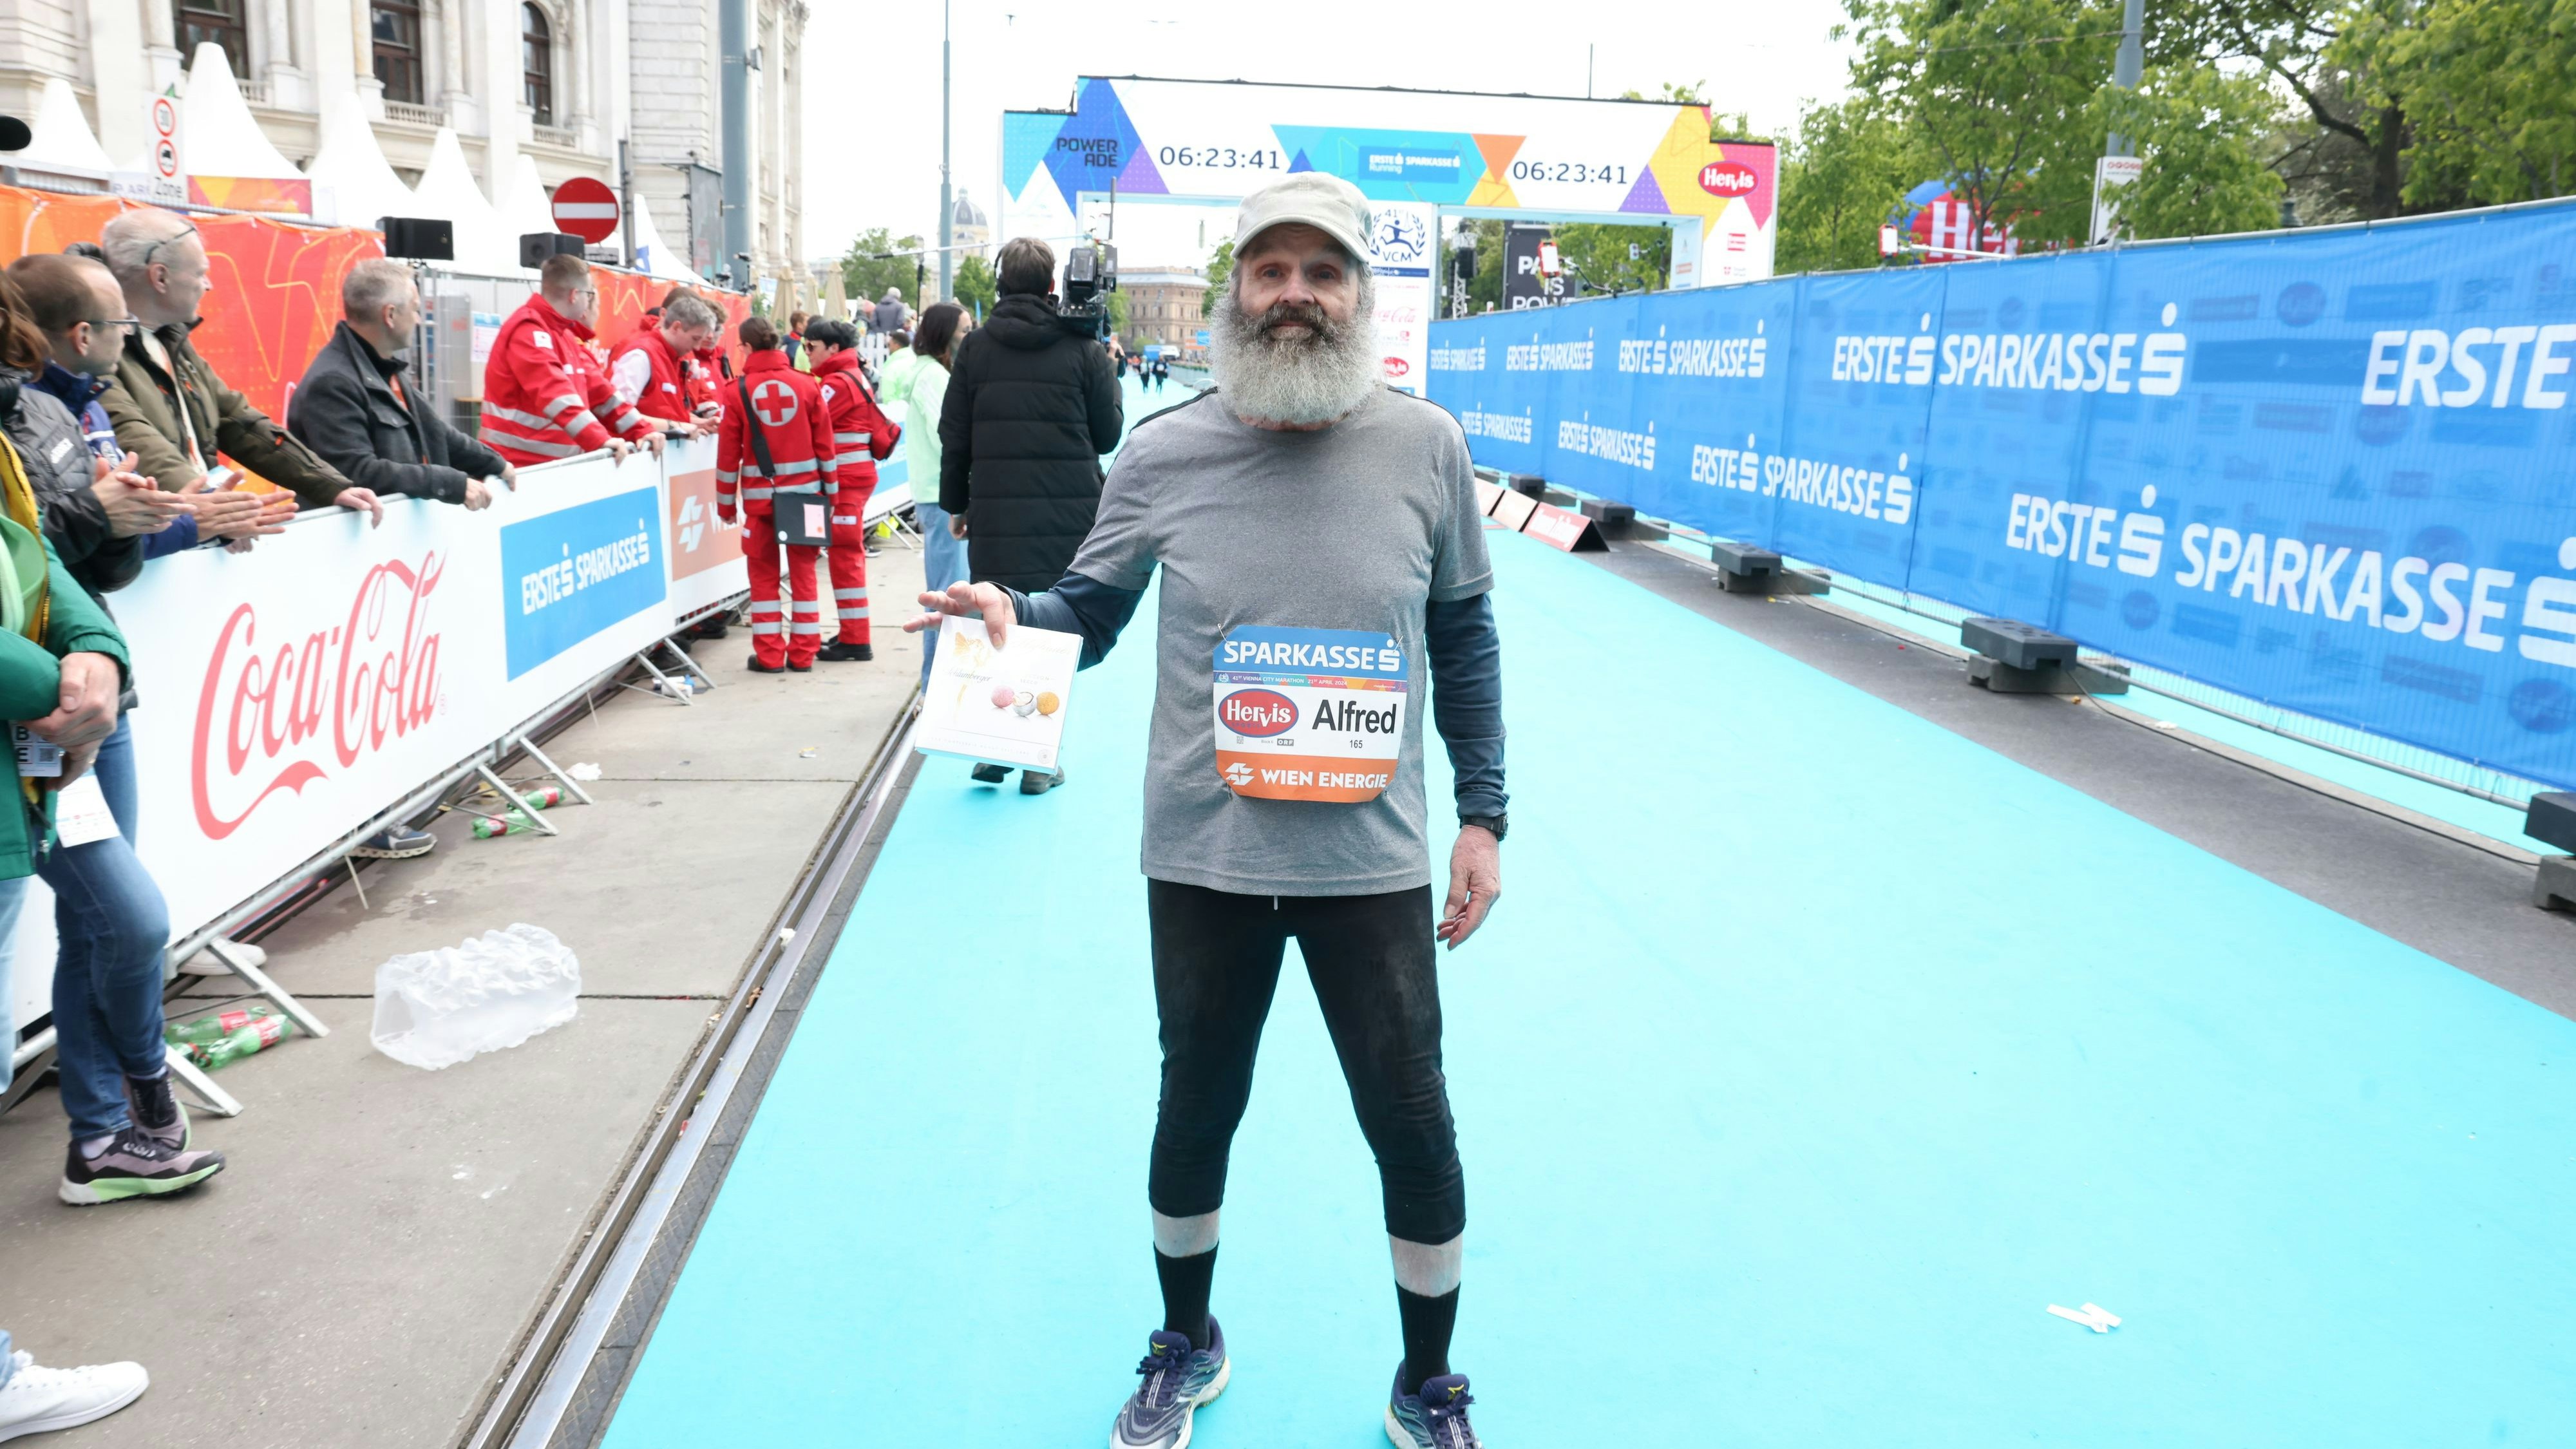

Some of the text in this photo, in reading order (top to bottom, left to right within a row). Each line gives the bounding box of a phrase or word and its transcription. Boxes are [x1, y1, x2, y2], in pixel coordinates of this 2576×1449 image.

[1056, 138, 1118, 153] POWER
[1159, 146, 1280, 169] 06:23:41
[1084, 153, 1118, 167] ADE
[1368, 163, 1403, 175] Running
[1369, 155, 1452, 167] ERSTE SPARKASSE
[1513, 161, 1628, 185] 06:23:41
[1704, 167, 1754, 191] Hervis
[155, 176, 183, 198] Zone
[1383, 251, 1412, 263] VCM
[1544, 278, 1564, 296] IS
[1430, 348, 1444, 370] ERSTE
[1506, 341, 1586, 371] ERSTE SPARKASSE
[1618, 338, 1749, 378] ERSTE SPARKASSE
[1832, 332, 2138, 394] ERSTE SPARKASSE
[2360, 323, 2576, 410] ERSTE
[1482, 413, 1524, 443] SPARKASSE
[1557, 420, 1645, 468] ERSTE SPARKASSE
[1690, 444, 1884, 520] ERSTE SPARKASSE
[522, 535, 639, 616] ERSTE SPARKASSE
[2005, 493, 2516, 653] ERSTE SPARKASSE
[1223, 640, 1376, 670] SPARKASSE
[1227, 699, 1291, 727] Hervis
[1311, 699, 1397, 734] Alfred
[15, 726, 30, 741] B
[1349, 739, 1363, 749] 165
[1261, 768, 1388, 788] WIEN ENERGIE
